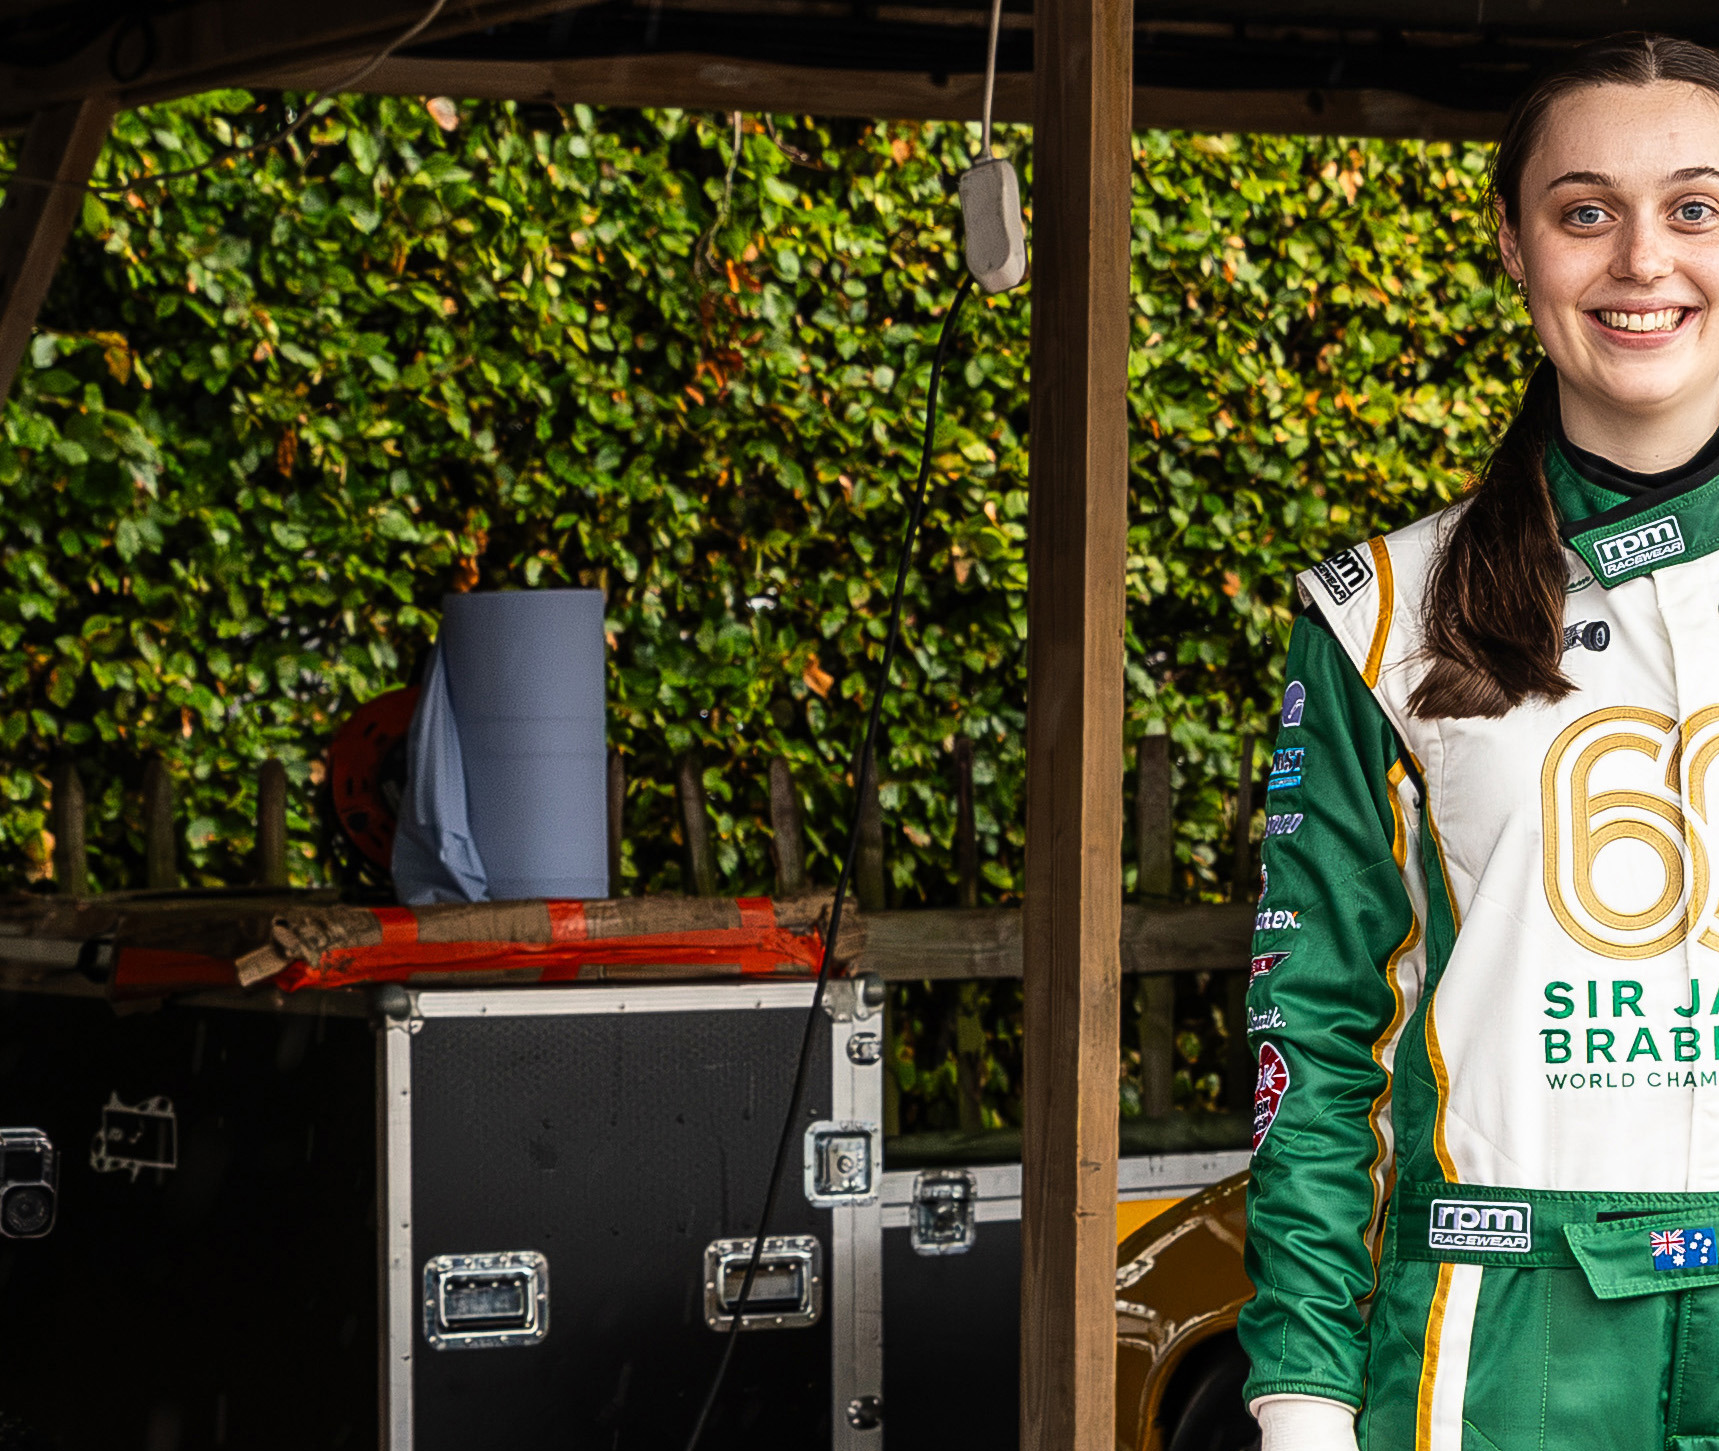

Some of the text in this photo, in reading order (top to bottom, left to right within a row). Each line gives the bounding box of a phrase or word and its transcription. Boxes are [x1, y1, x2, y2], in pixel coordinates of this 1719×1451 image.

[1600, 522, 1676, 561] rpm
[1607, 541, 1681, 574] RACEWEAR
[1543, 979, 1643, 1020] SIR
[1545, 1072, 1636, 1090] WORLD
[1439, 1206, 1523, 1232] rpm
[1433, 1232, 1528, 1248] RACEWEAR
